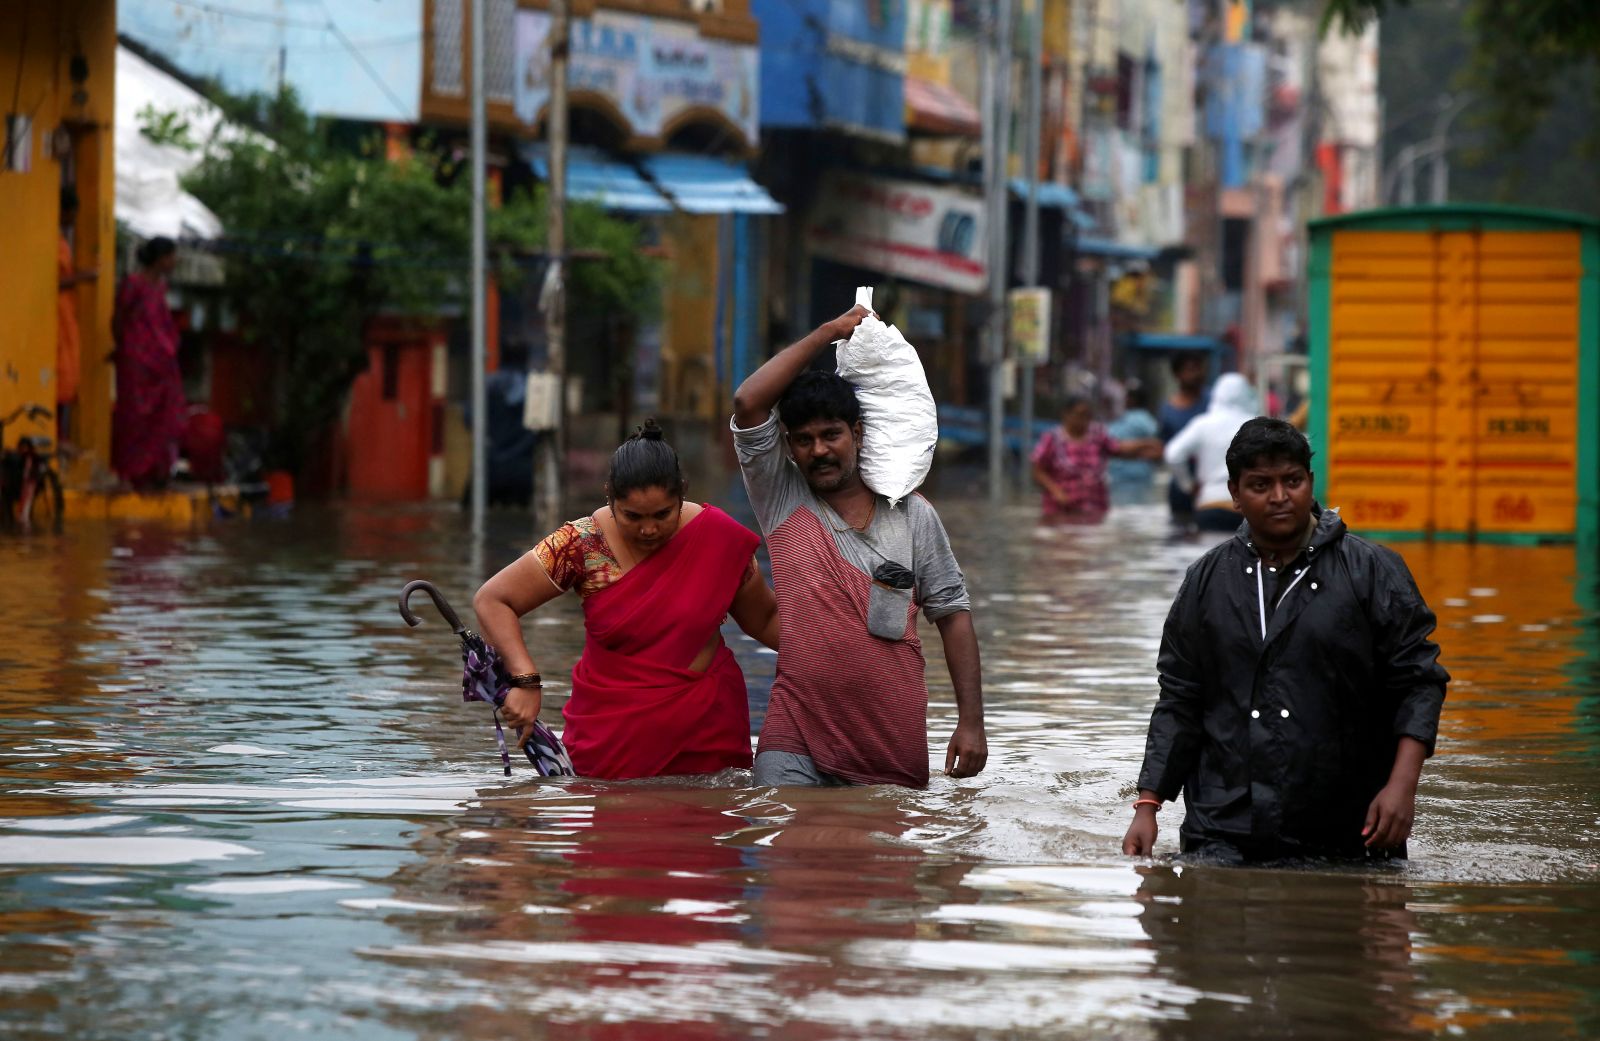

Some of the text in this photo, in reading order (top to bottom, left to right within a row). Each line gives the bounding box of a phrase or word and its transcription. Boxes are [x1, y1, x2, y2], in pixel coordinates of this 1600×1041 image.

[1338, 414, 1549, 435] SOUND HORN
[1352, 500, 1409, 523] STOP
